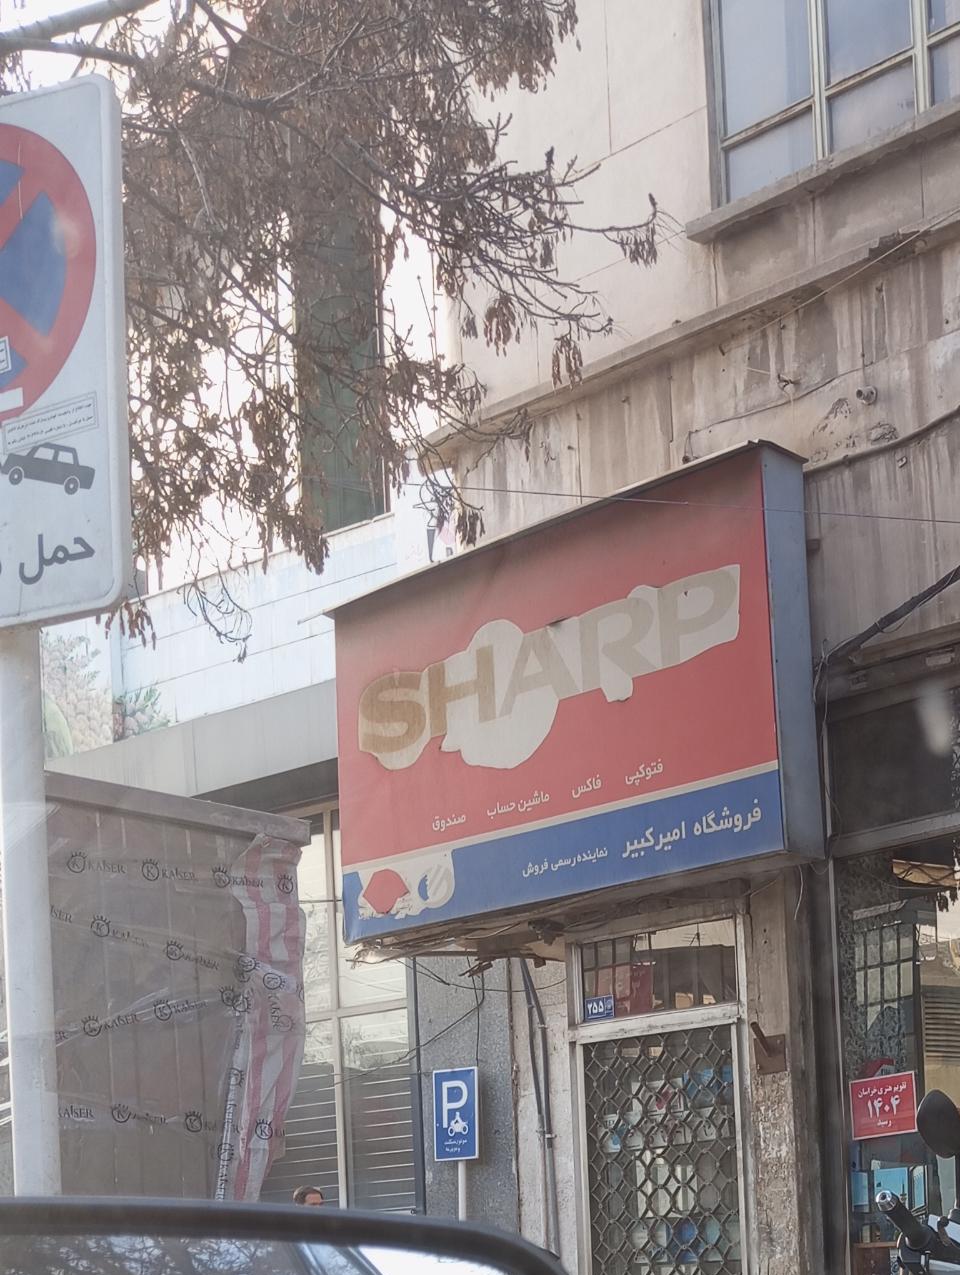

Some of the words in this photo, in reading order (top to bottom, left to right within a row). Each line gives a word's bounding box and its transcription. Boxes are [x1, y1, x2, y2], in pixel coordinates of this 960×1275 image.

[19, 533, 95, 585] حمل
[360, 568, 740, 754] SHARP
[625, 758, 664, 785] فتوکپی
[572, 775, 601, 798] فاکس
[487, 801, 516, 817] حساب
[518, 791, 550, 812] ماشین
[432, 814, 466, 831] صندوق
[693, 798, 762, 837] فروشگاه
[551, 857, 576, 871] رسمی
[576, 847, 608, 862] نماینده
[522, 861, 549, 877] فروش
[442, 1080, 468, 1128] P
[868, 1095, 900, 1119] ۱۴۰۴
